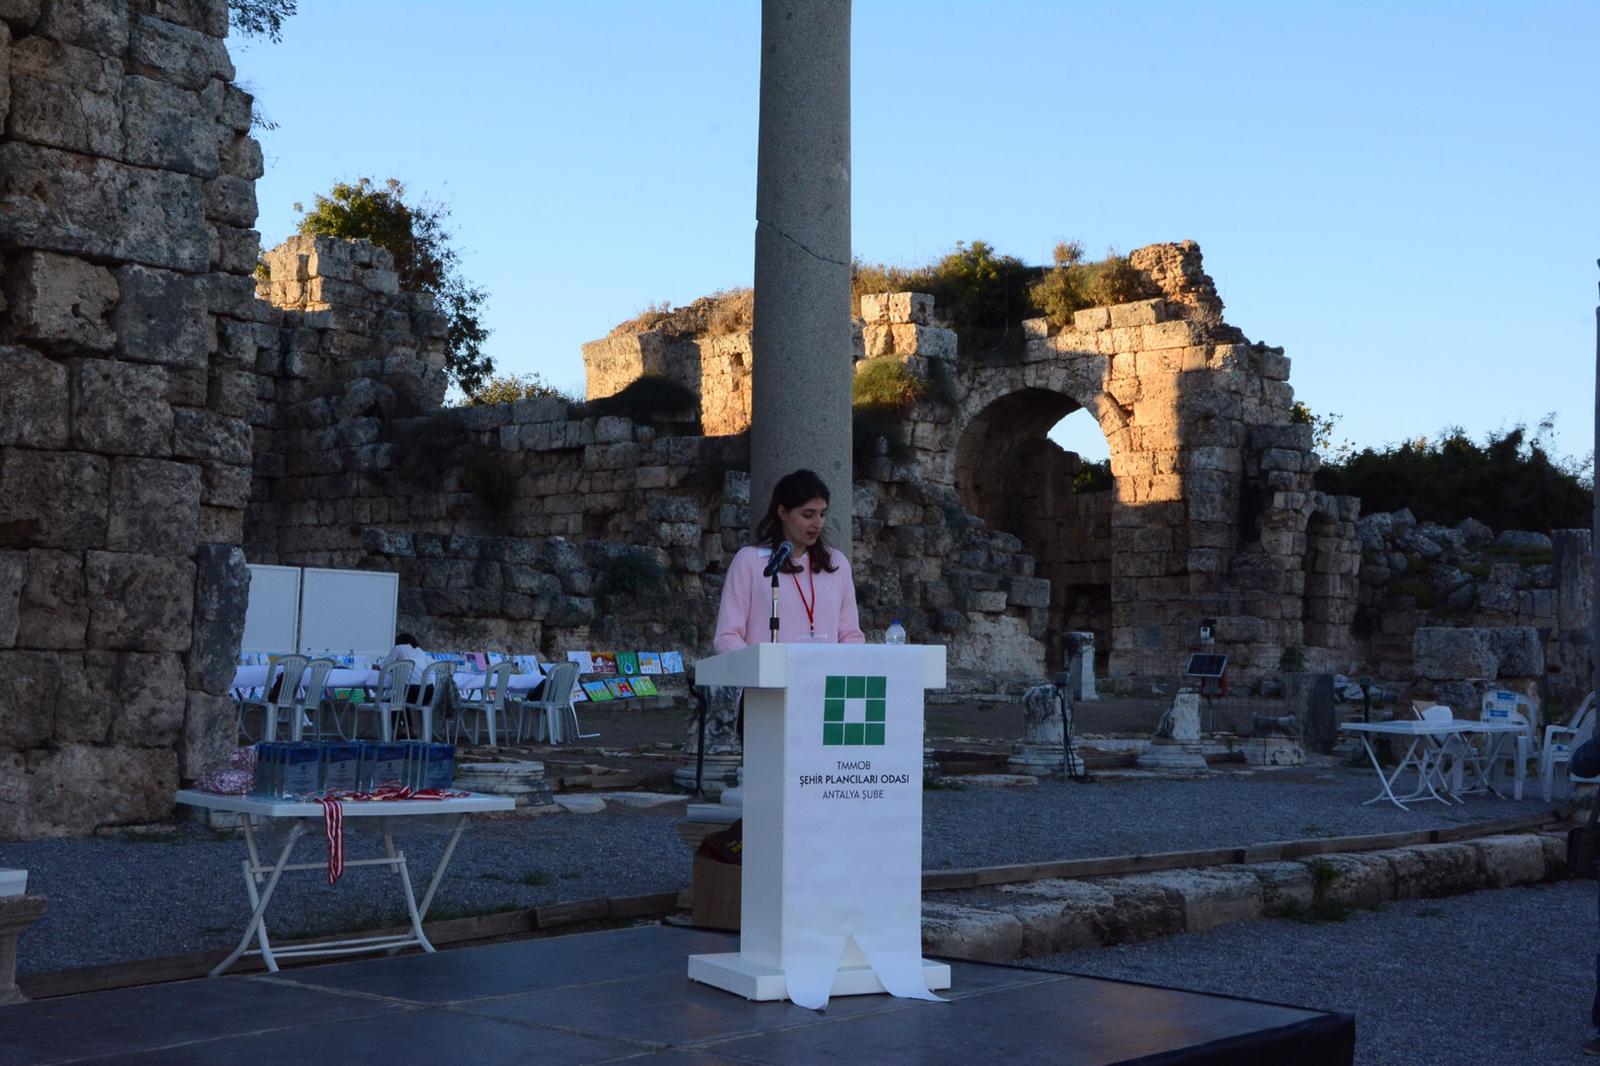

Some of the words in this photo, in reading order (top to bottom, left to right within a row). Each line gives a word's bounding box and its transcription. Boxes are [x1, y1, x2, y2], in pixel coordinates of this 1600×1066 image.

[837, 760, 871, 770] TMMOB
[799, 773, 823, 788] ŞEHİR
[825, 774, 878, 784] PLANCILARI
[880, 774, 910, 784] ODASI
[822, 790, 860, 799] ANTALYA
[862, 789, 885, 800] ŞUBE
